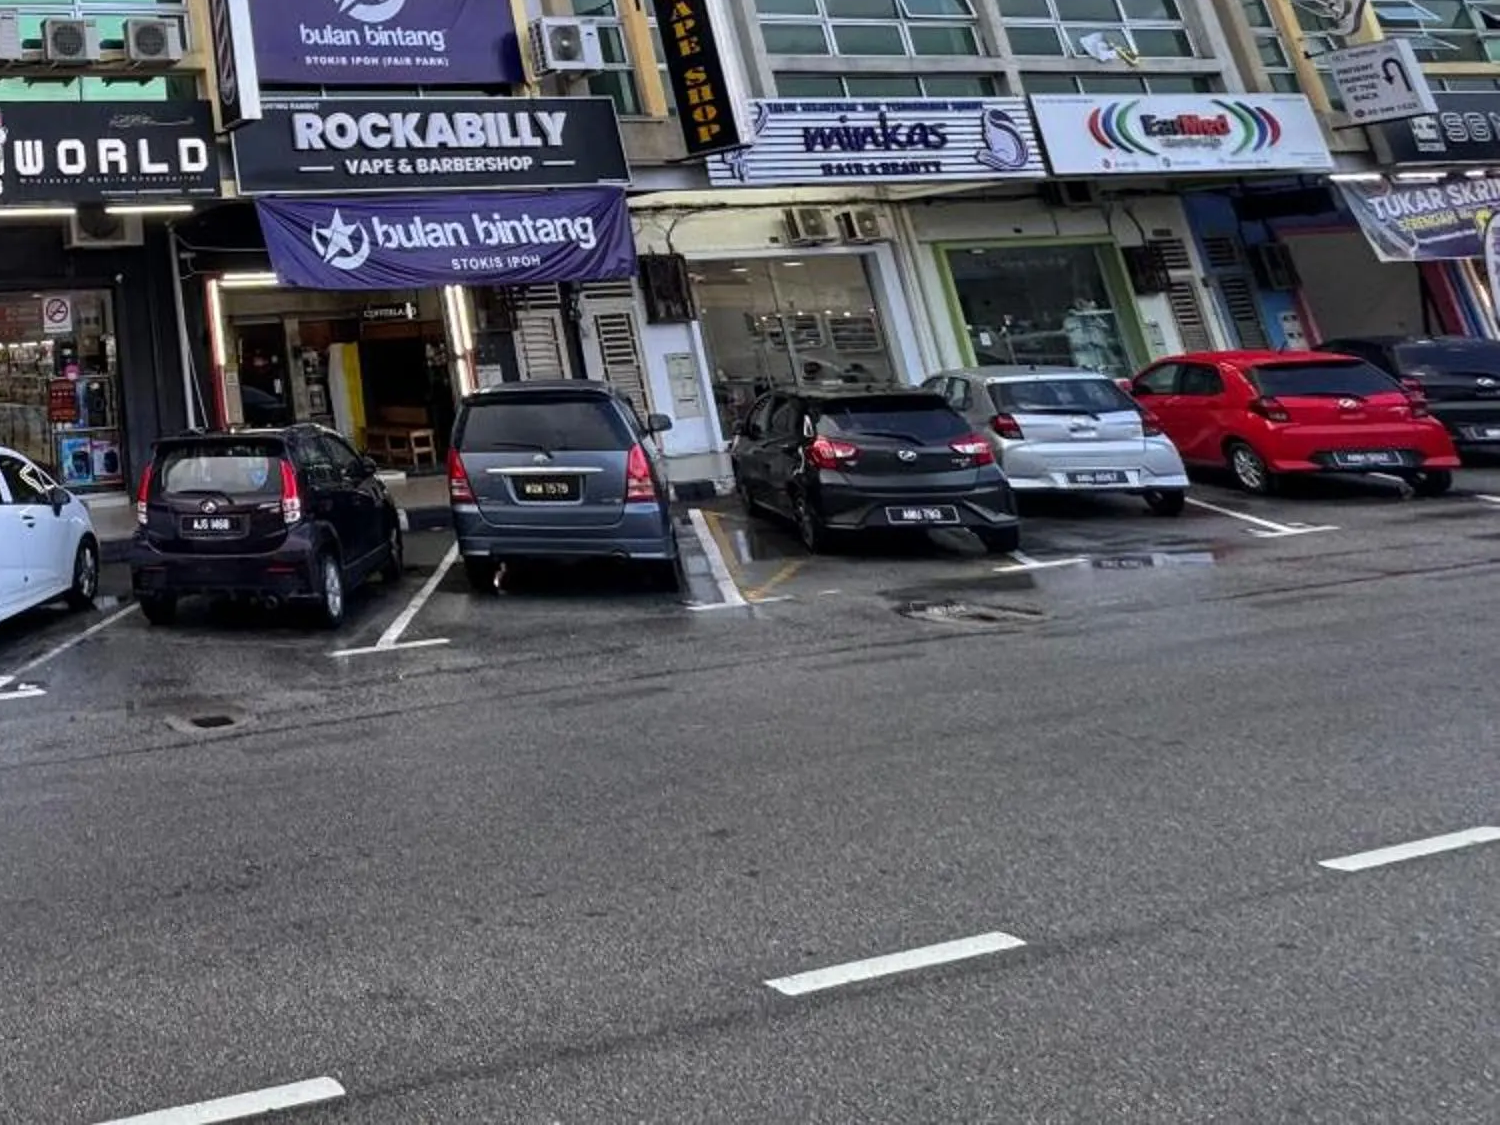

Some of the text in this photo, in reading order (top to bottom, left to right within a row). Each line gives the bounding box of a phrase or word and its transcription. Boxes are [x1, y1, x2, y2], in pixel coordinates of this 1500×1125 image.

[300, 24, 446, 52] bulan bintang
[304, 56, 348, 66] STOKIS
[351, 56, 379, 65] IPOH
[684, 66, 721, 143] SHOP
[293, 111, 568, 151] ROCKABILLY
[13, 137, 209, 176] WORLD
[346, 156, 533, 174] VAPE & BARBERSHOP
[1367, 190, 1447, 220] TUKAR
[1447, 178, 1500, 207] SKRI
[372, 213, 597, 250] bulan bintang
[452, 255, 541, 271] STOKIS IPOH
